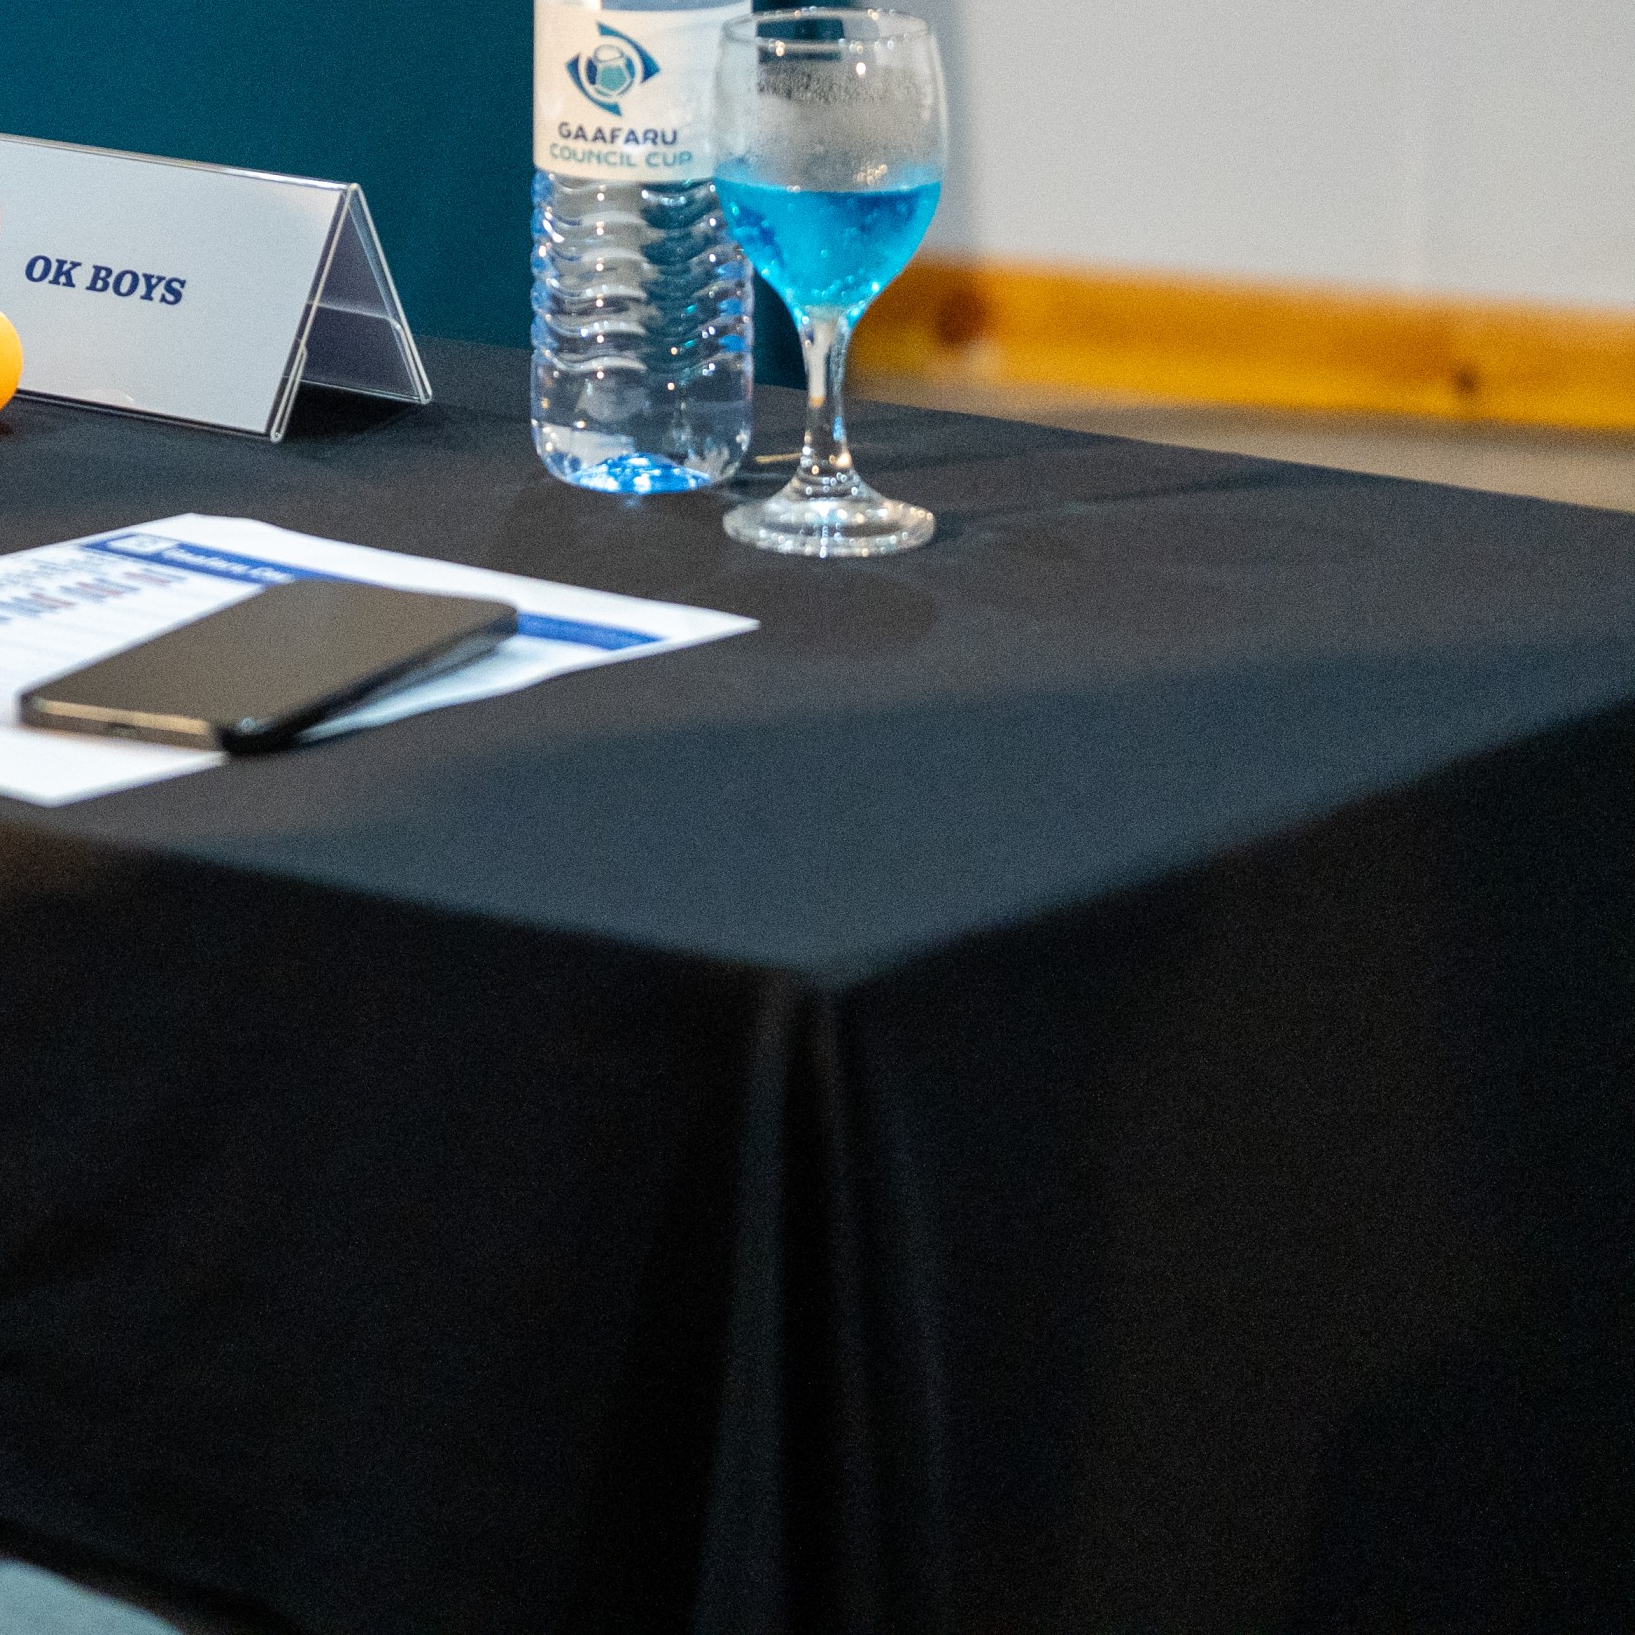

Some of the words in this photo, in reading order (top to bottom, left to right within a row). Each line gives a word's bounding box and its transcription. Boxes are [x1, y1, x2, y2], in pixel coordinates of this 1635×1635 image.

[558, 122, 678, 145] GAAFARU
[550, 143, 638, 167] COUNCIL
[645, 151, 693, 168] CUP
[25, 255, 82, 288] OK
[85, 264, 187, 305] BOYS
